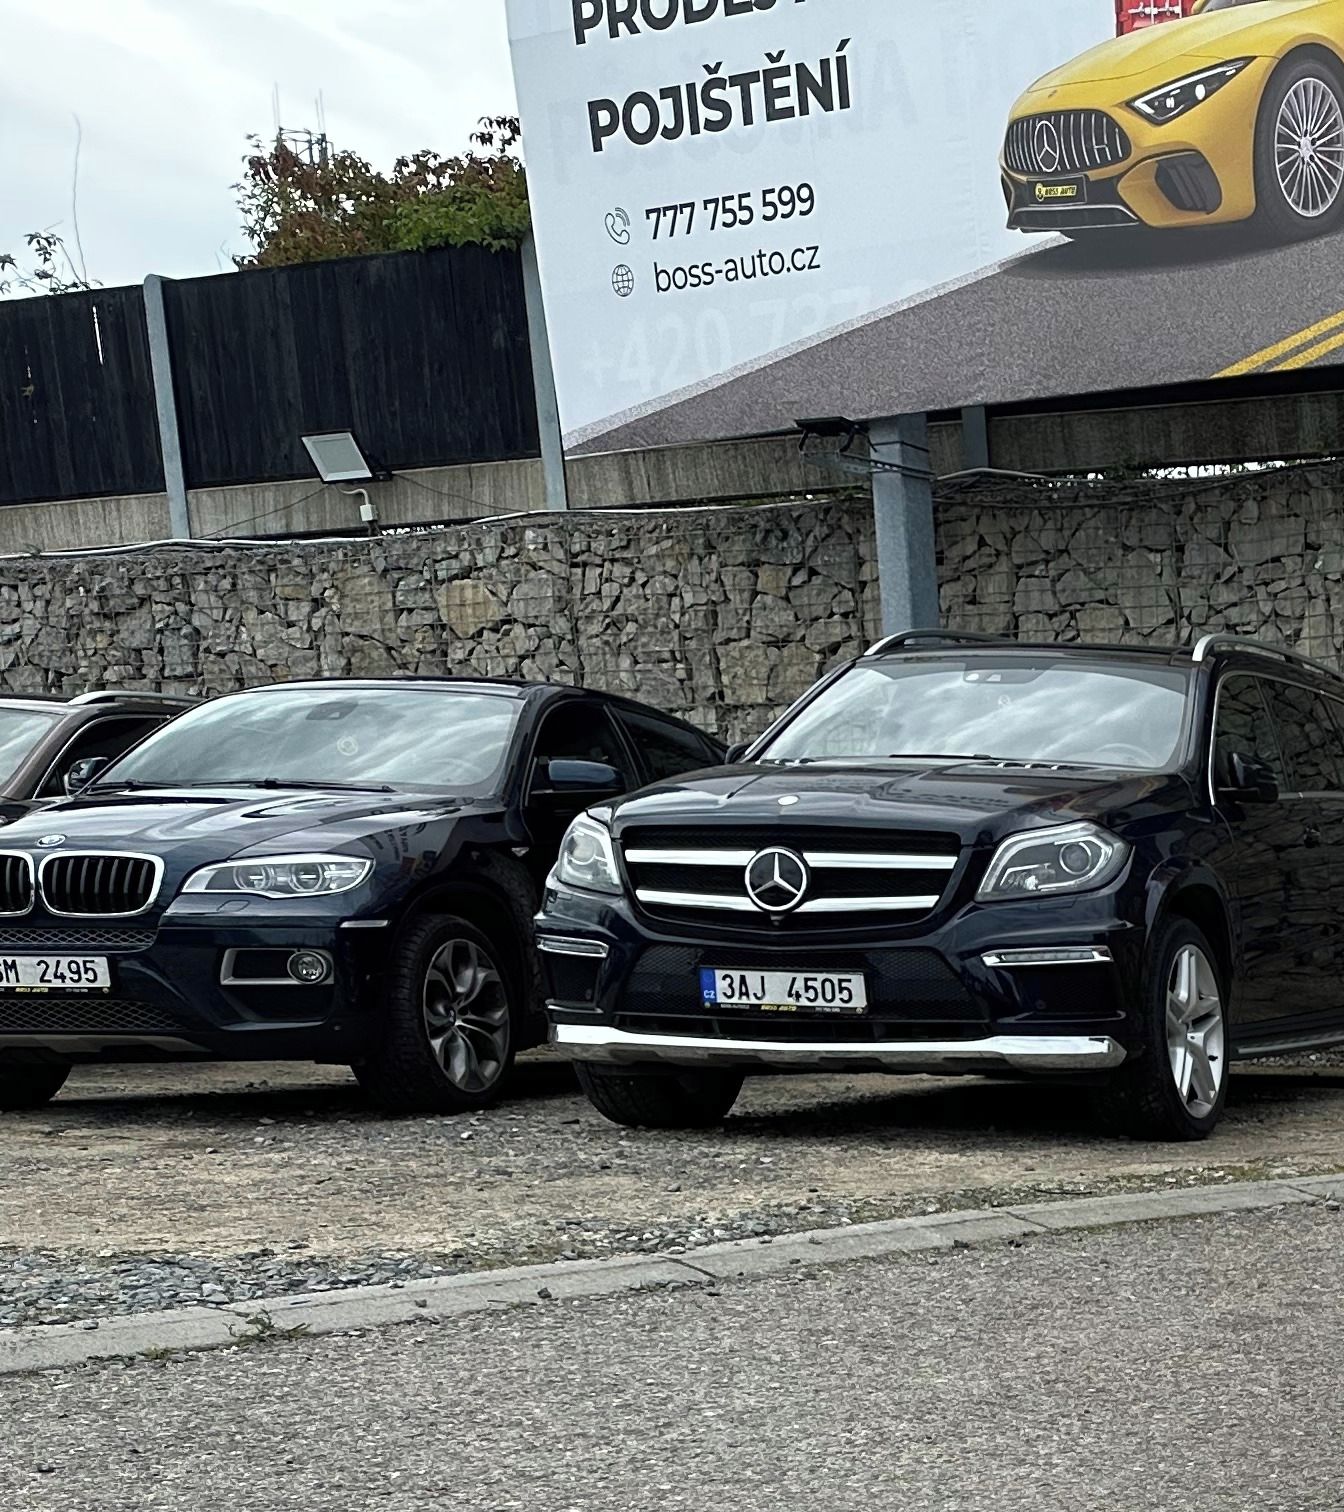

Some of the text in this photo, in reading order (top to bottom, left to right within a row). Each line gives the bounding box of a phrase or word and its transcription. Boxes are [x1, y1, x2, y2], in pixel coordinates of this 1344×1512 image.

[572, 0, 777, 45] PRO
[587, 38, 851, 153] POJIŠTĚNÍ
[645, 182, 815, 240] 777 755 599
[653, 245, 821, 293] boss-auto.cz
[0, 958, 98, 984] M 2495
[721, 973, 853, 1004] 3AJ 4505
[703, 989, 716, 999] CZ
